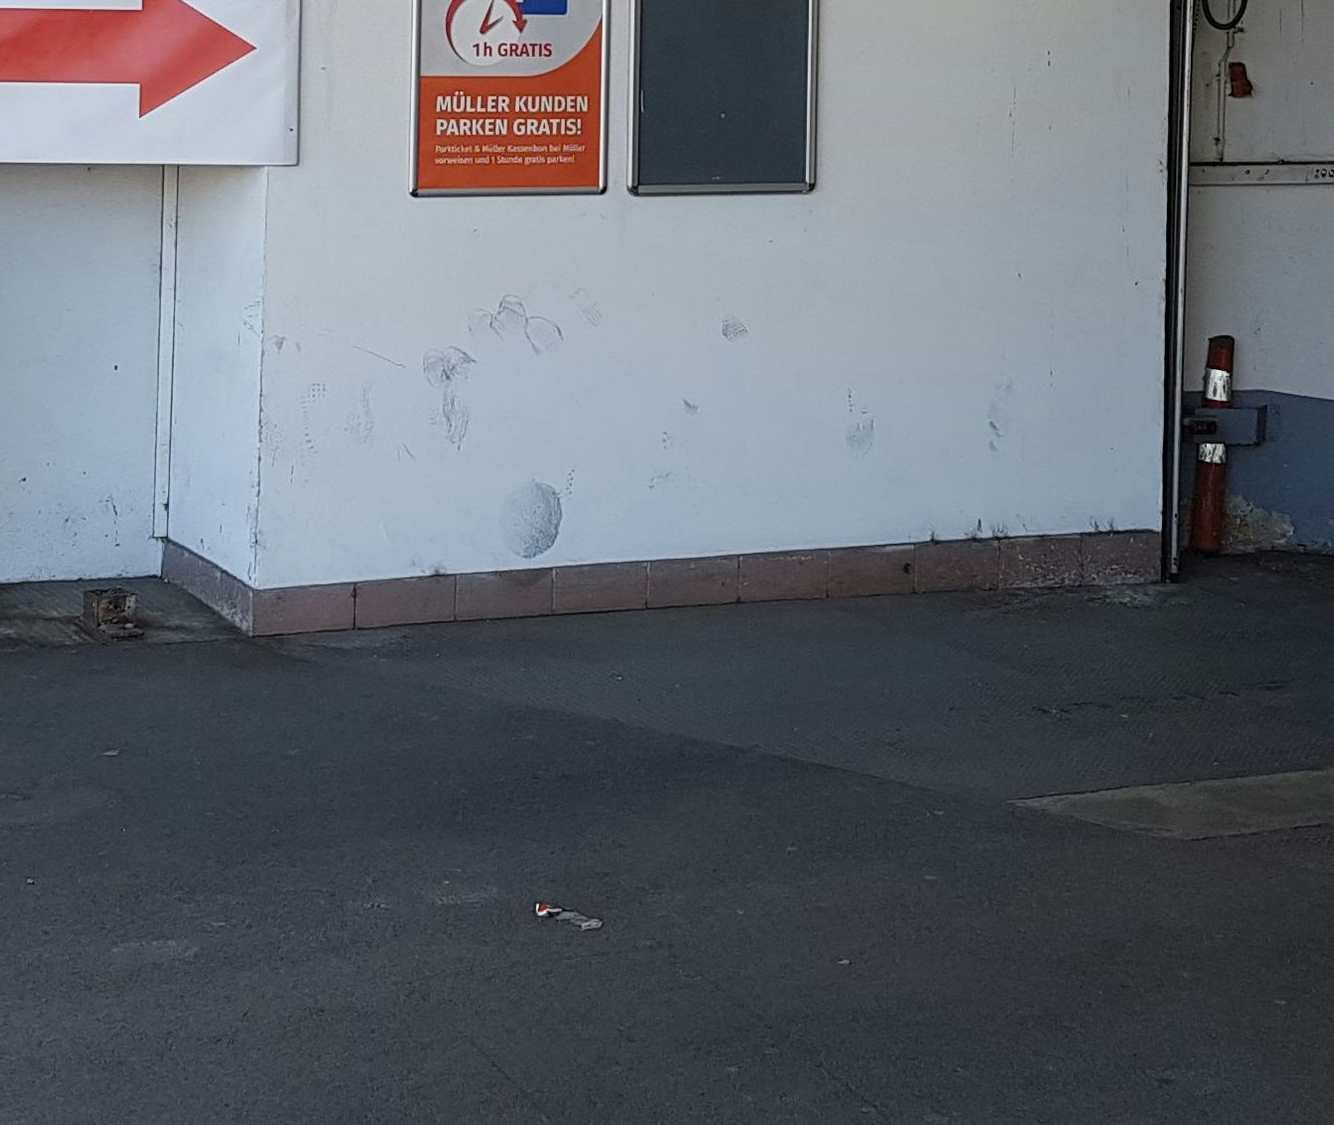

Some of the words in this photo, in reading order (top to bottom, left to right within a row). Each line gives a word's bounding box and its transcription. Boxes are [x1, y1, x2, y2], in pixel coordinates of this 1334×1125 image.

[472, 43, 480, 57] 1
[483, 42, 493, 57] h
[497, 43, 553, 57] GRATIS
[436, 91, 510, 113] MÜLLER
[514, 95, 589, 113] KUNDEN
[436, 118, 508, 136] PARKEN
[512, 118, 583, 136] GRATIS!
[475, 156, 490, 164] und
[497, 156, 523, 164] Stunde
[524, 156, 546, 165] gratis
